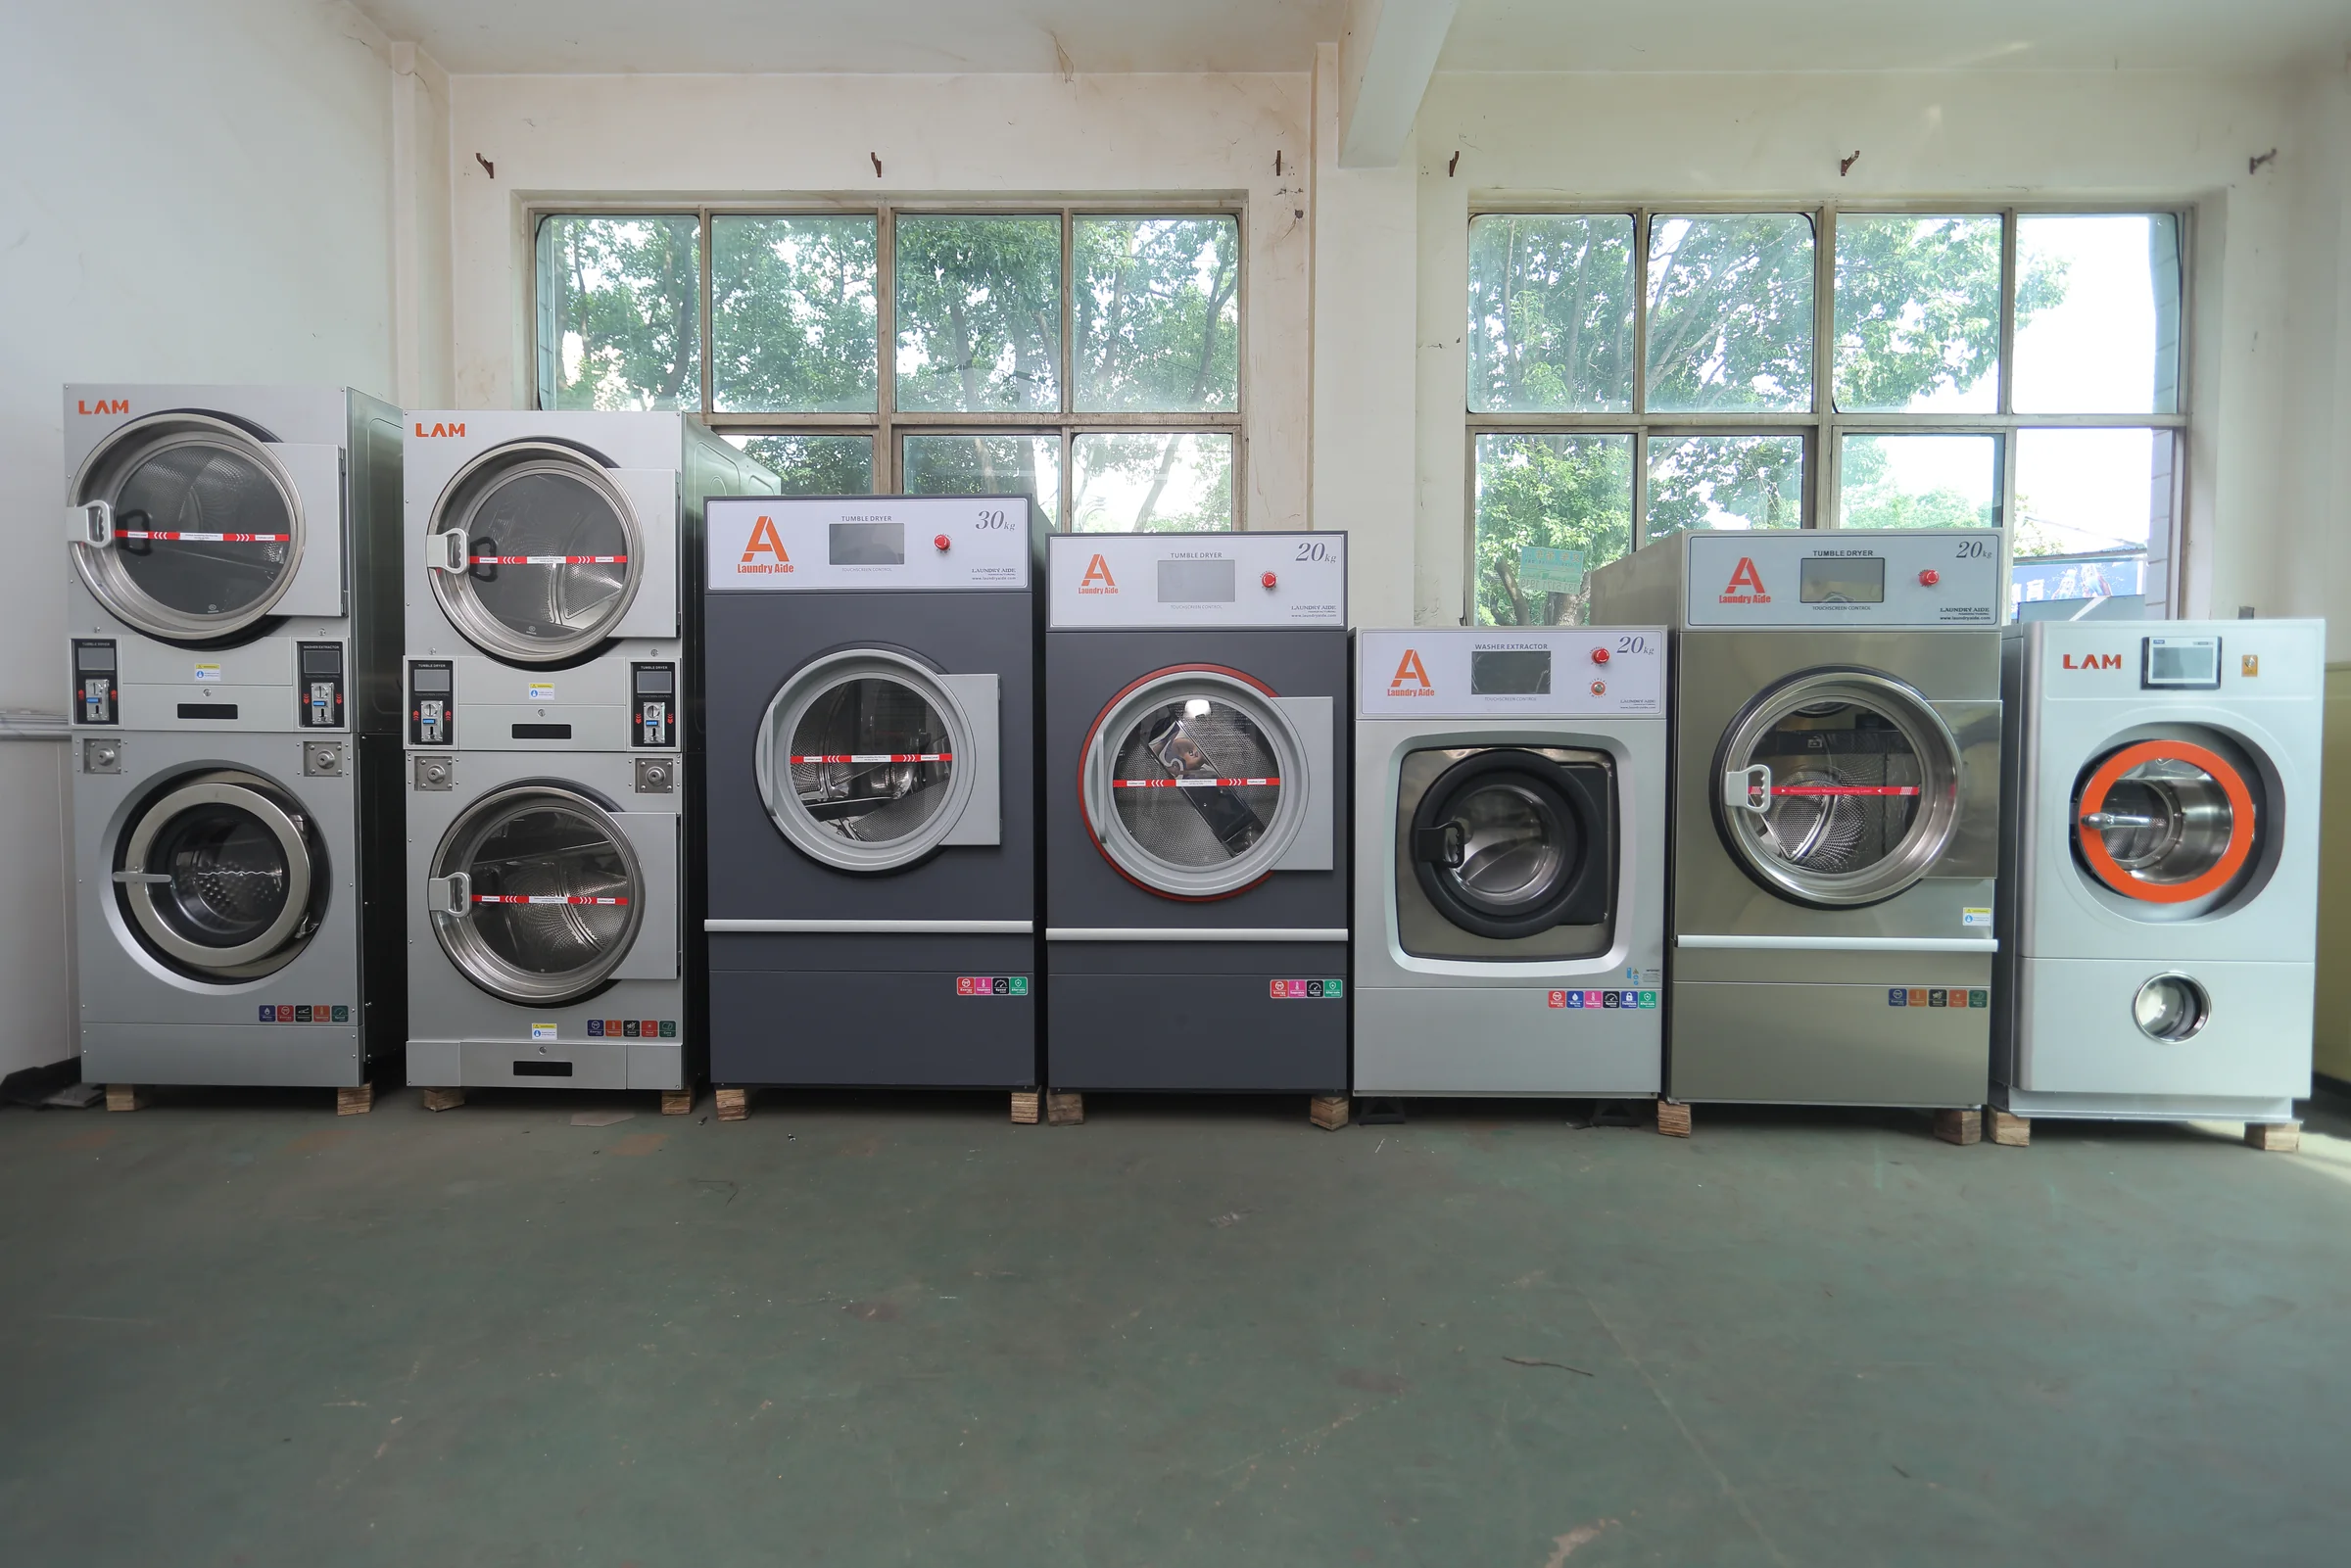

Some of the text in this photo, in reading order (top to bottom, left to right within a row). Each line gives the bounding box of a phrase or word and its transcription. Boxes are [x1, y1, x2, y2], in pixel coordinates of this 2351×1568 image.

[78, 400, 129, 415] LAM
[415, 422, 465, 438] LAM
[741, 515, 790, 562] A
[737, 563, 794, 575] Laundry Aide
[1081, 553, 1116, 587] A
[1725, 556, 1766, 594] A
[1719, 594, 1771, 604] Laundry Aide
[1390, 648, 1431, 688] A
[2062, 653, 2122, 670] LAM
